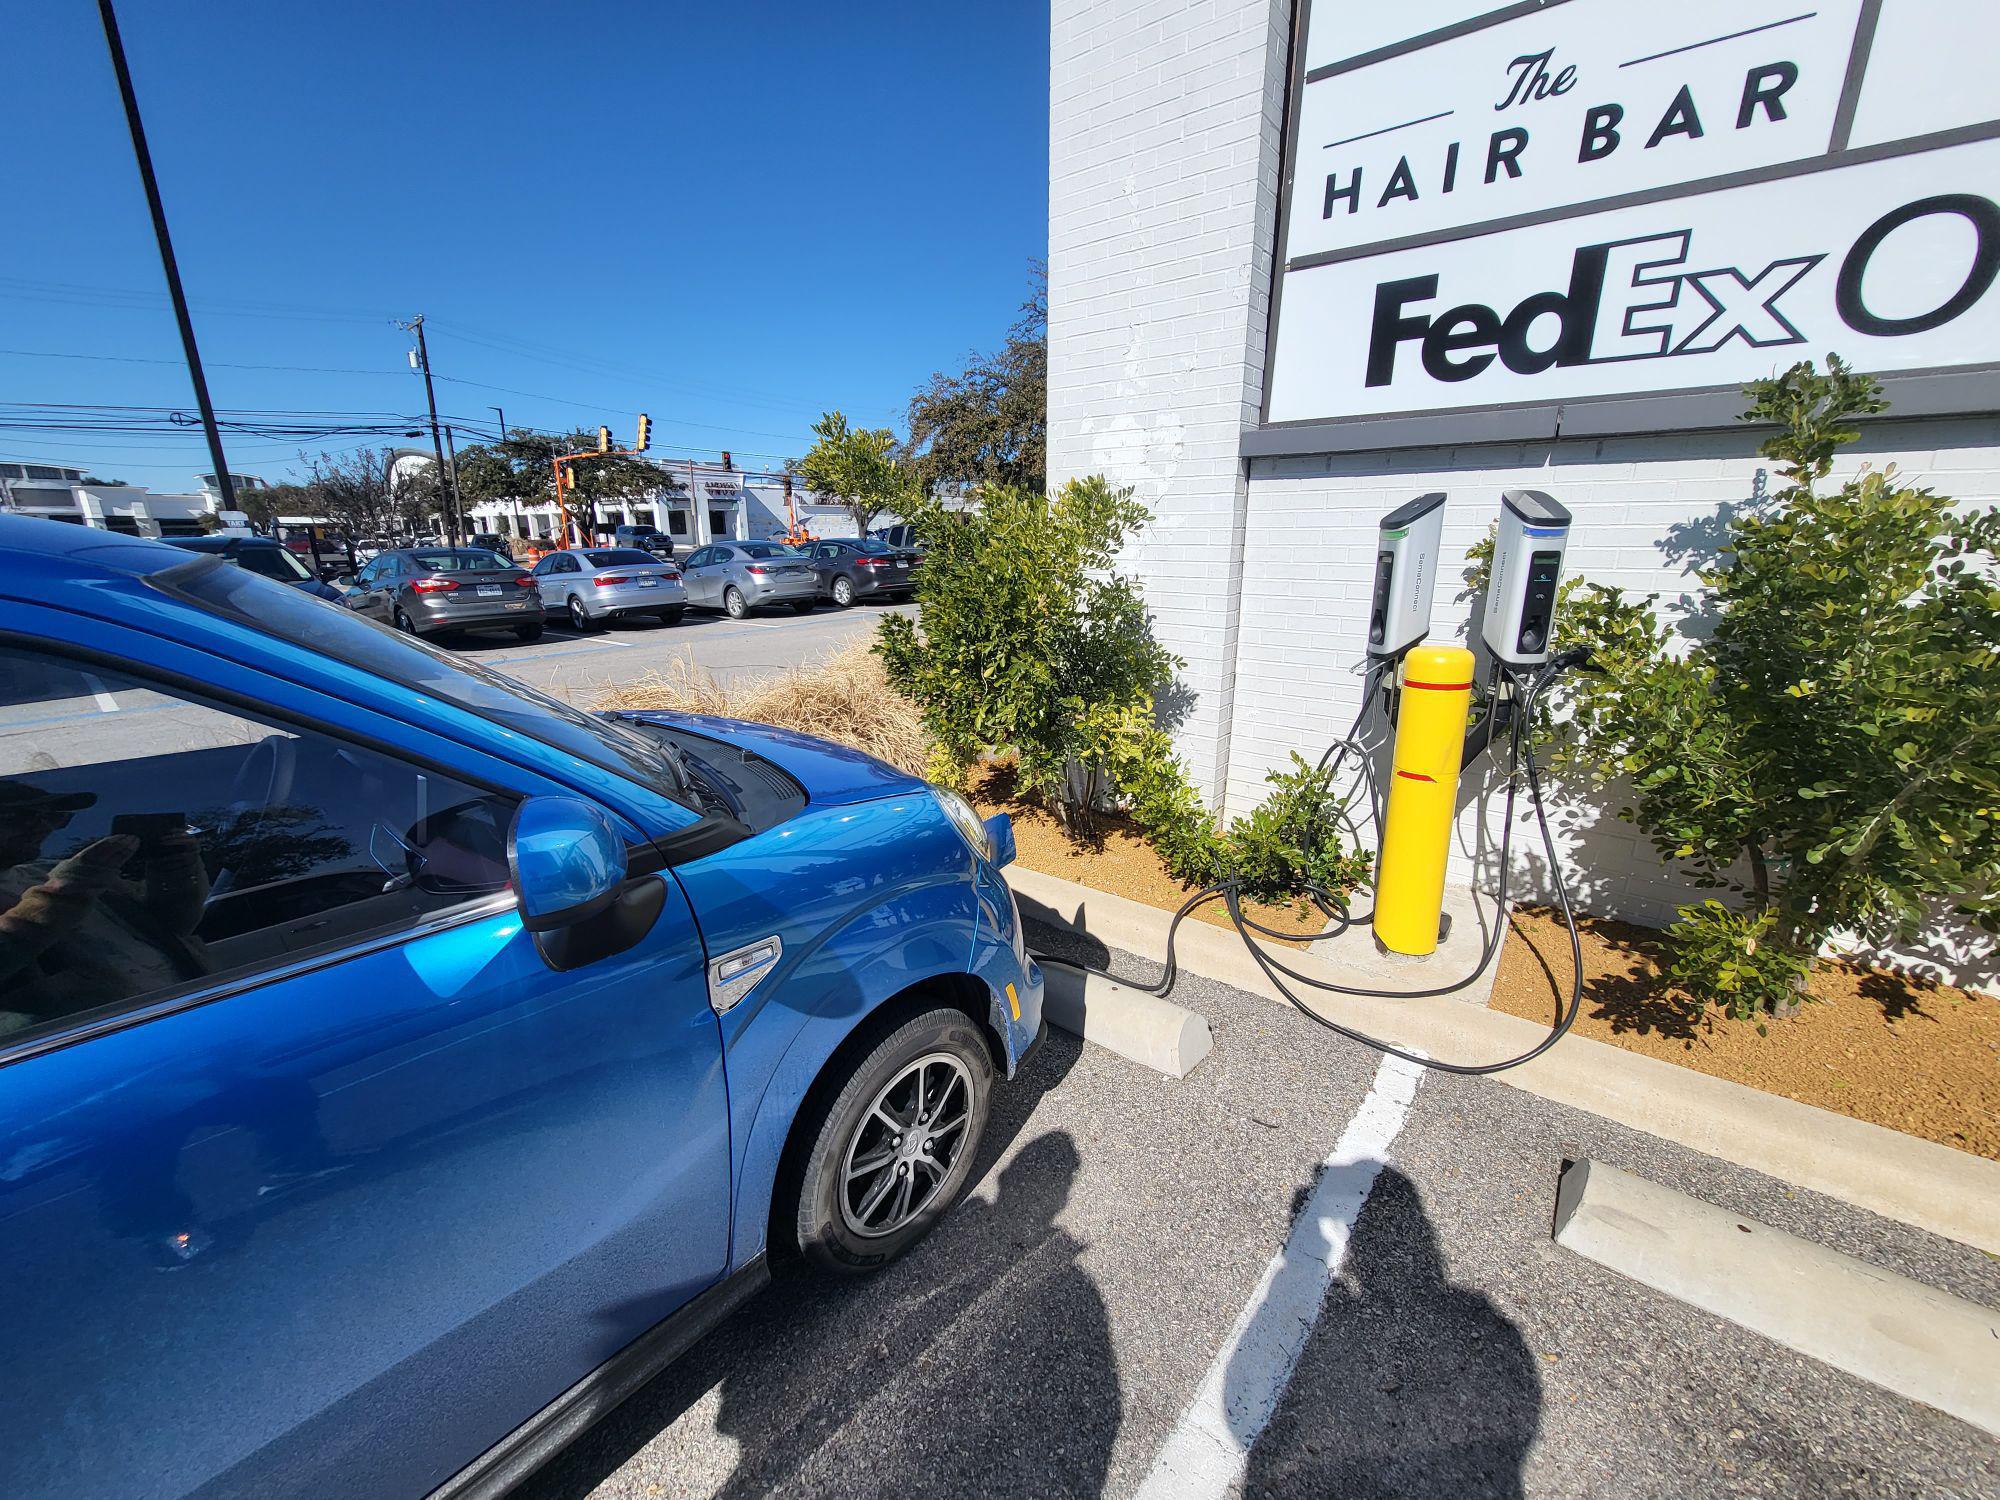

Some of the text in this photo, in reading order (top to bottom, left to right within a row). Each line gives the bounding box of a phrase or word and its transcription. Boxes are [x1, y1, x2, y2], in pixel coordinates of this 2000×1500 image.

[1322, 60, 1799, 220] HAIR BAR
[1495, 47, 1577, 111] The
[1364, 228, 1829, 388] FedEx
